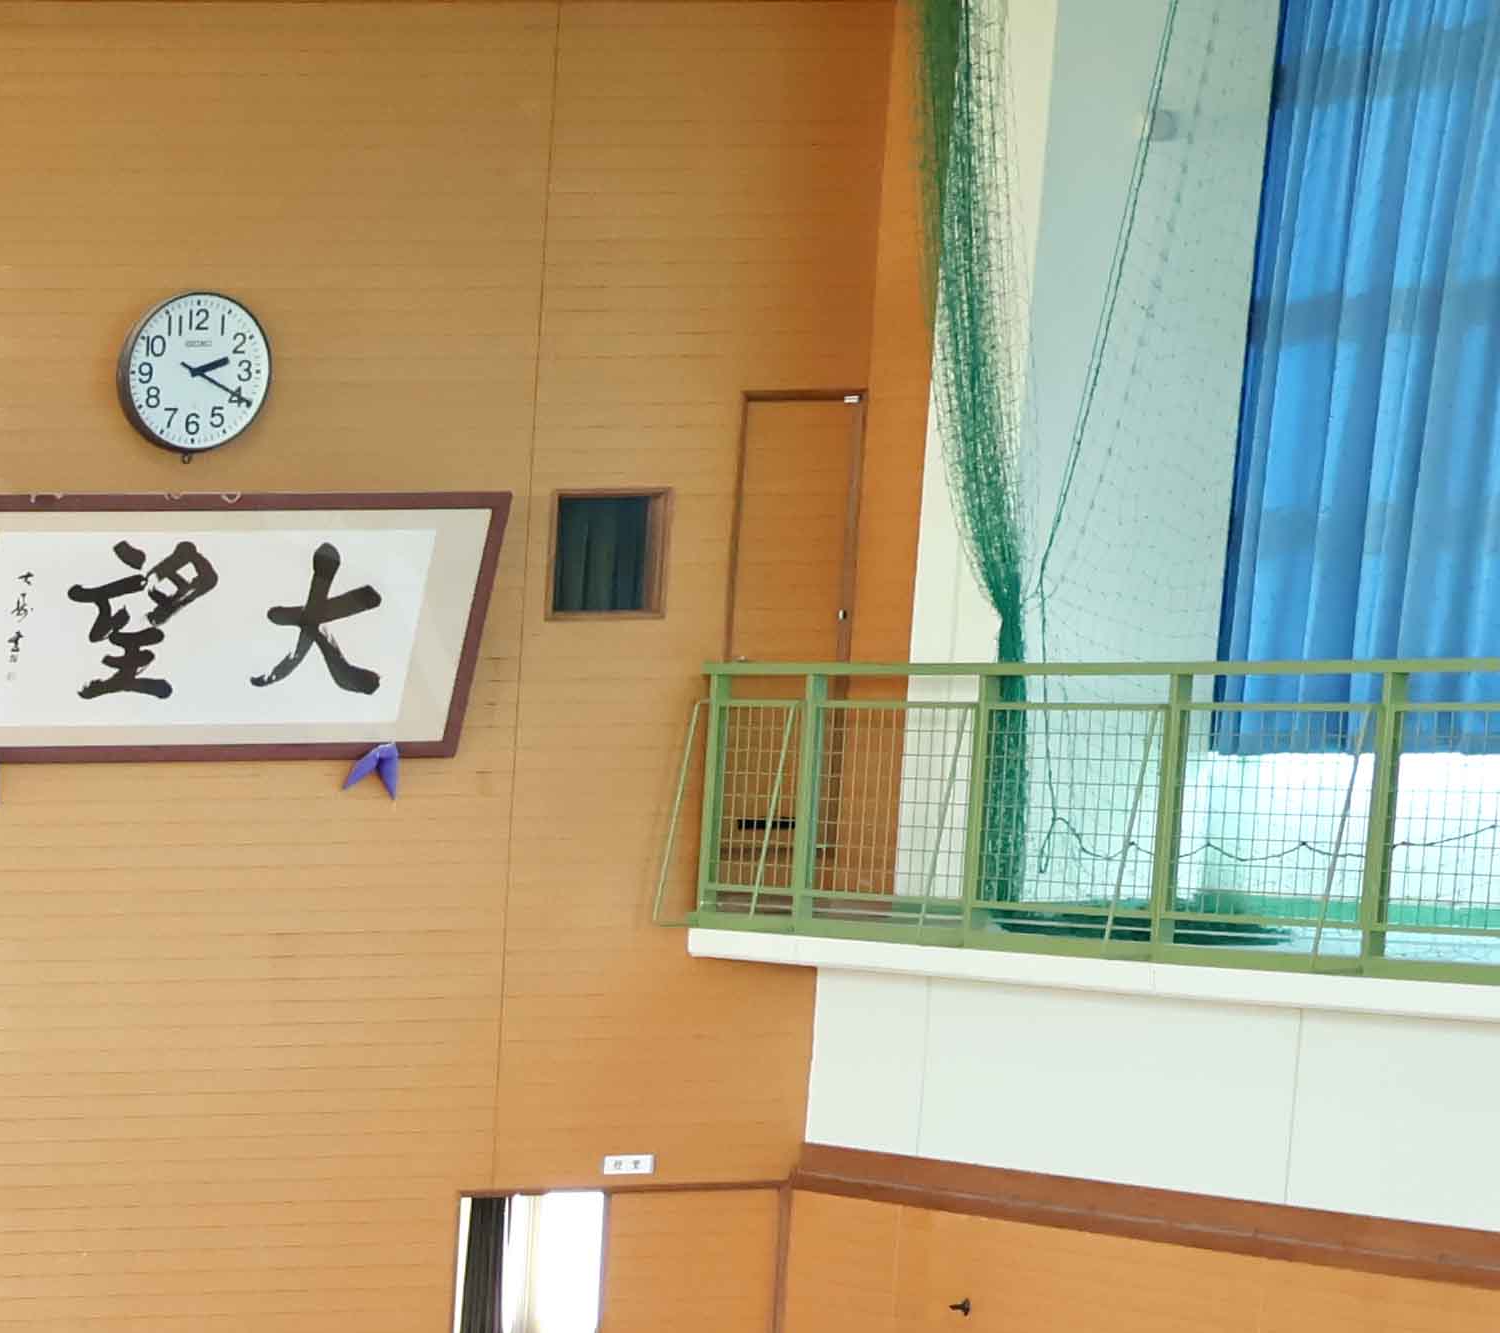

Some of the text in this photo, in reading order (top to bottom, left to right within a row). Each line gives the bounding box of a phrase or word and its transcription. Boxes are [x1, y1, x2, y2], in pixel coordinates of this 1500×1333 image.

[168, 314, 183, 336] 11
[189, 309, 209, 331] 12
[221, 314, 226, 336] 1
[146, 335, 166, 357] 10
[232, 332, 246, 354] 2
[138, 362, 153, 384] 9
[237, 359, 252, 381] 3
[145, 386, 160, 408] 8
[164, 407, 178, 428] 7
[185, 413, 199, 435] 6
[210, 406, 224, 428] 5
